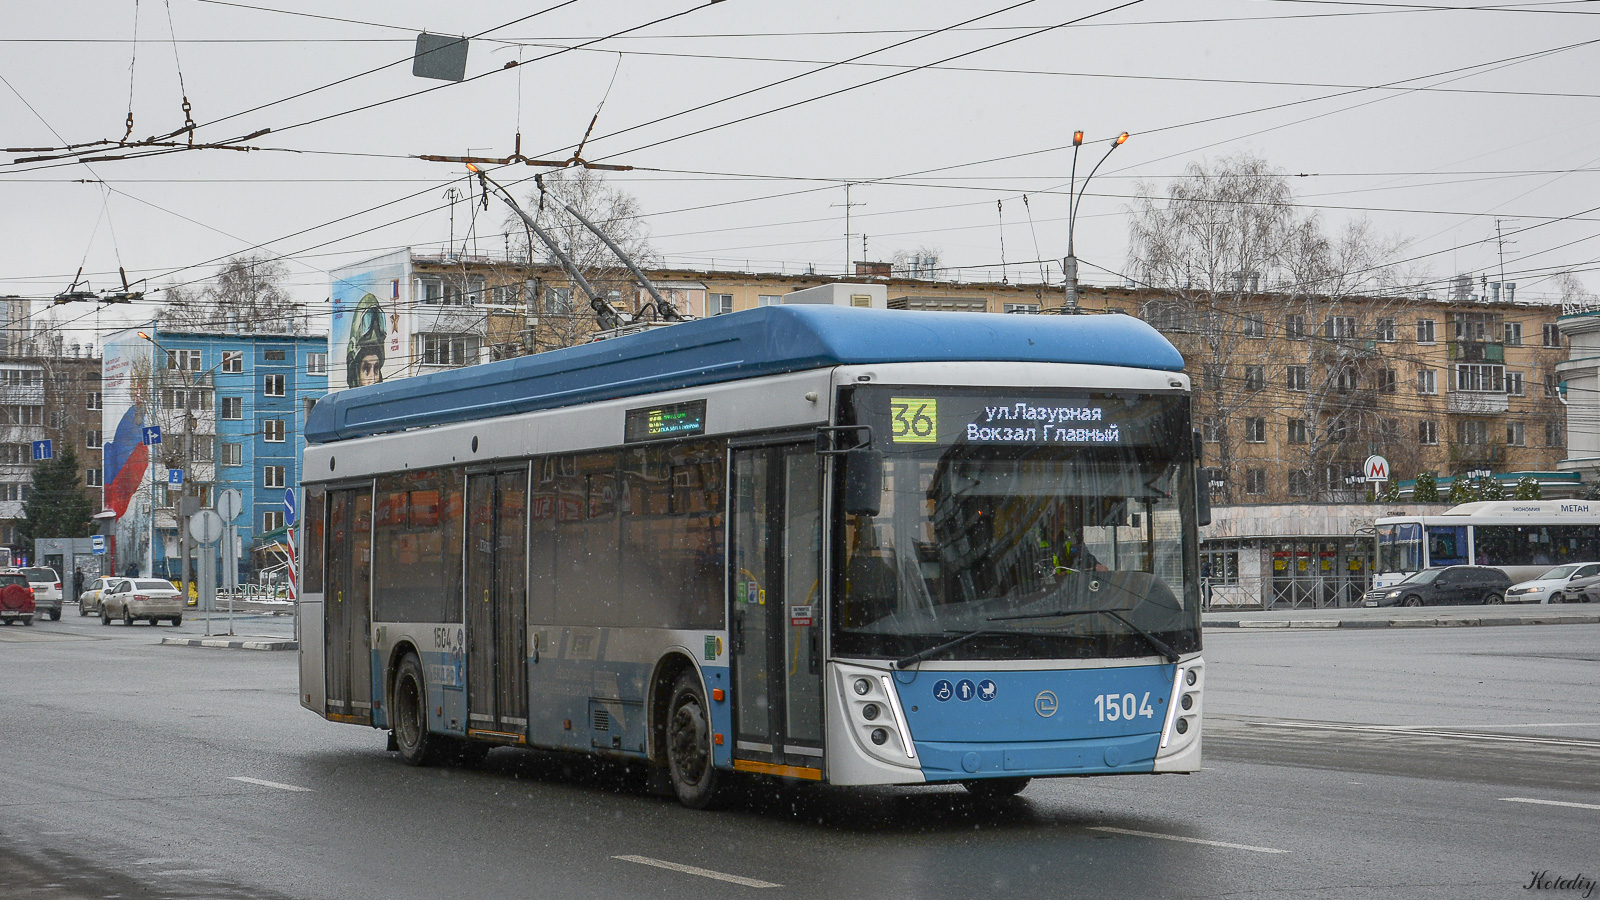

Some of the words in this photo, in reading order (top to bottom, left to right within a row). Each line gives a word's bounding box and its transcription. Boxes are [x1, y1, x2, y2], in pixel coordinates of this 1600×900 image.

[891, 403, 934, 437] 36
[985, 402, 1103, 422] ул.Лазурная
[966, 424, 1037, 442] Вокзал
[1043, 423, 1120, 443] Главный
[1560, 504, 1589, 512] МЕТАН
[433, 627, 452, 649] 1504
[1094, 691, 1154, 722] 1504
